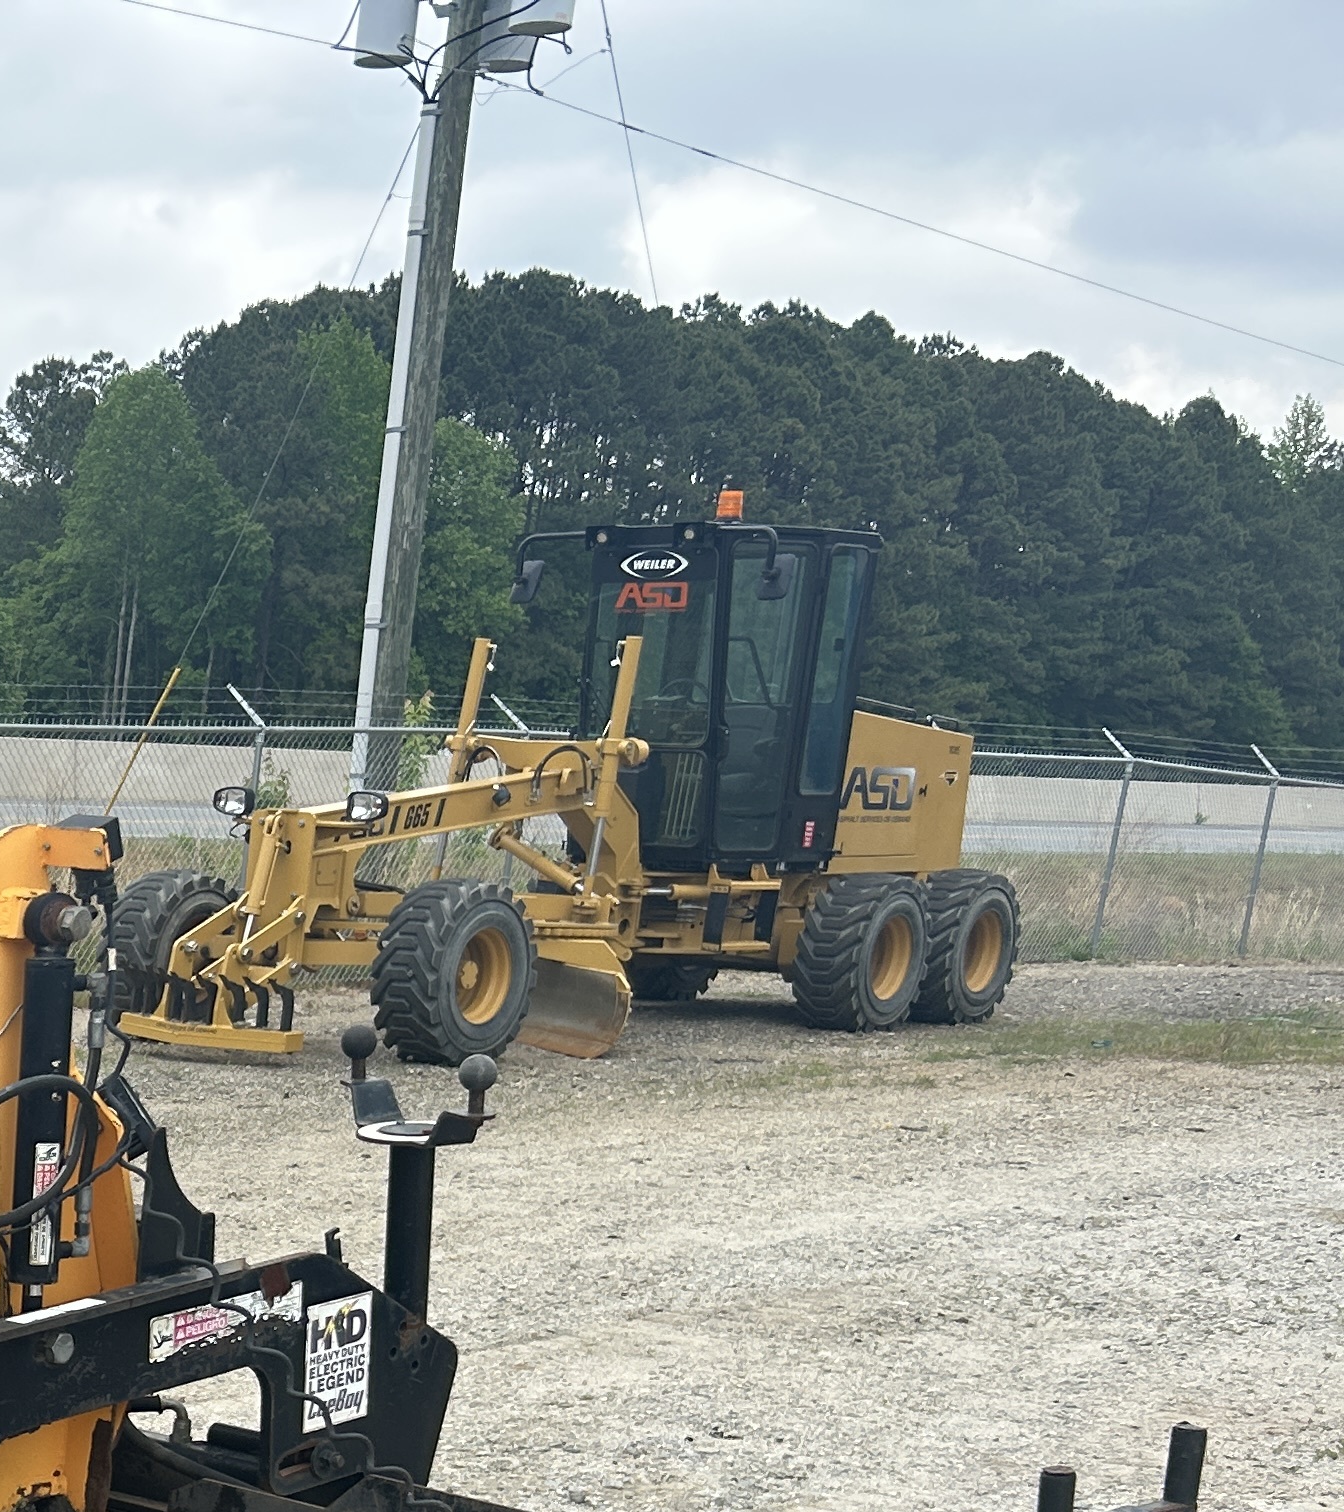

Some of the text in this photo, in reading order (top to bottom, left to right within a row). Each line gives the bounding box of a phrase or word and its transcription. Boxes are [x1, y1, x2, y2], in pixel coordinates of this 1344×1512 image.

[633, 559, 676, 570] WEILER
[615, 581, 689, 608] ASD
[839, 767, 916, 811] ASD
[403, 802, 432, 830] G65
[308, 1354, 366, 1380] ELECTRIC
[309, 1343, 366, 1366] HEAVY DUTY
[308, 1367, 365, 1395] LEGEND
